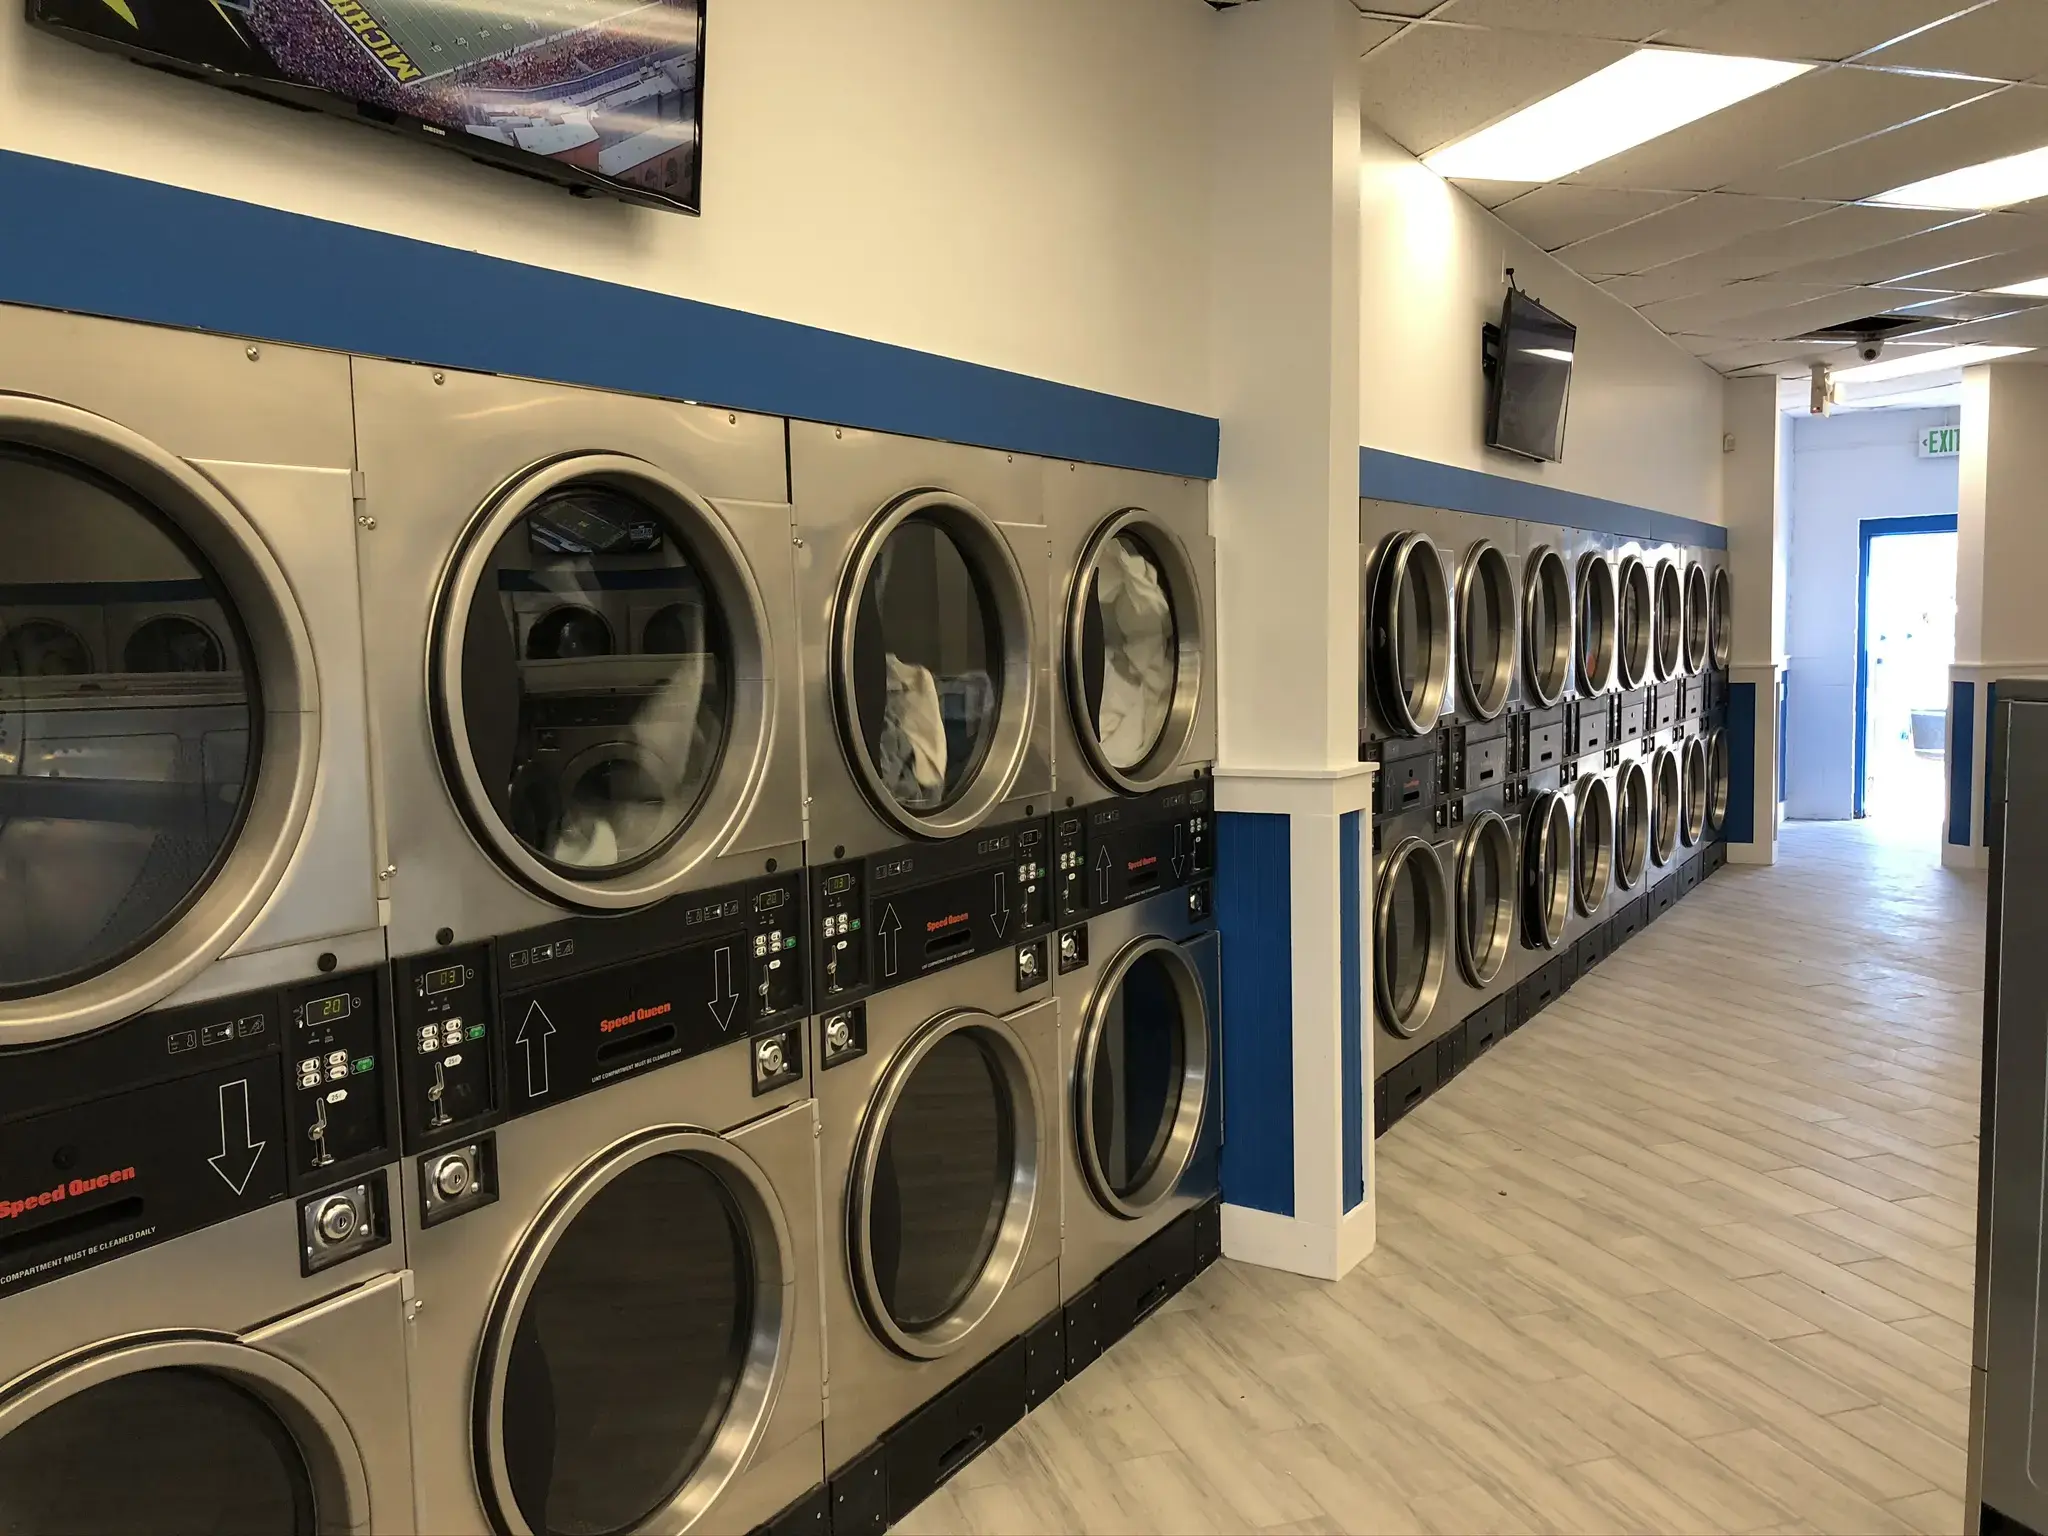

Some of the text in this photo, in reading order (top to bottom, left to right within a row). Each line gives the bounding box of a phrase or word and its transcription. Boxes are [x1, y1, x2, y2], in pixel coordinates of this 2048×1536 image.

[1929, 428, 1960, 454] EXIT
[926, 912, 969, 932] Speed Queen
[323, 998, 341, 1016] 20
[600, 1002, 672, 1032] Speed Queen
[0, 1166, 135, 1218] Speed Queen
[0, 1225, 156, 1285] COMPARTMENT MUST BE CLEANED DAILY
